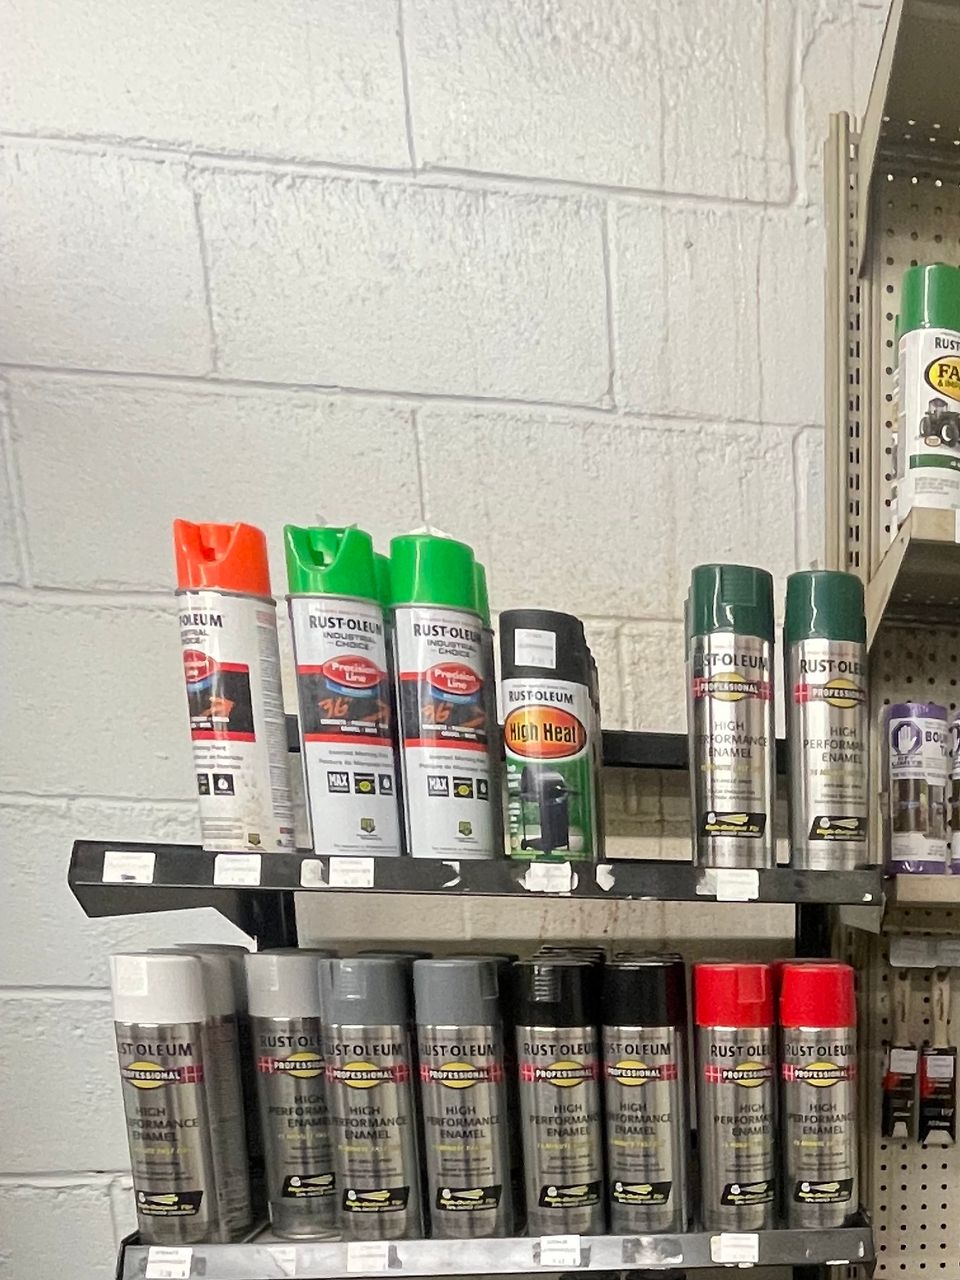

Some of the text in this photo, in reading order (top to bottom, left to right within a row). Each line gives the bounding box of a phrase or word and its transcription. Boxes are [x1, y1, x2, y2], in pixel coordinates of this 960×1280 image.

[309, 615, 381, 635] RUST-OLEUM
[323, 632, 376, 644] INDUSTRIAL
[335, 641, 369, 650] CHOICE
[438, 649, 470, 658] CHOICE
[331, 662, 377, 674] Precision
[345, 672, 367, 682] Line
[434, 668, 476, 682] Precision
[447, 678, 467, 690] Line
[509, 691, 574, 704] RUST-OLEUM
[714, 721, 745, 731] HIGH
[510, 722, 539, 743] High
[543, 723, 577, 744] Heat
[830, 727, 856, 738] HIGH
[709, 747, 753, 759] ENAMEL
[328, 774, 348, 787] MAX
[428, 776, 448, 789] MAX
[334, 1070, 393, 1080] PROFESSIONAL
[430, 1070, 488, 1080] PROFESSIONAL
[608, 1067, 661, 1078] PROFESSIONAL
[794, 1070, 848, 1079] PROFESSIONAL
[349, 1106, 380, 1115] HIGH
[446, 1106, 476, 1115] HIGH
[553, 1104, 583, 1113] HIGH
[809, 1103, 836, 1112] HIGH
[345, 1129, 391, 1140] ENAMEL
[440, 1129, 485, 1139] ENAMEL
[547, 1127, 589, 1137] ENAMEL
[614, 1126, 656, 1135] ENAMEL
[802, 1126, 844, 1135] ENAMEL
